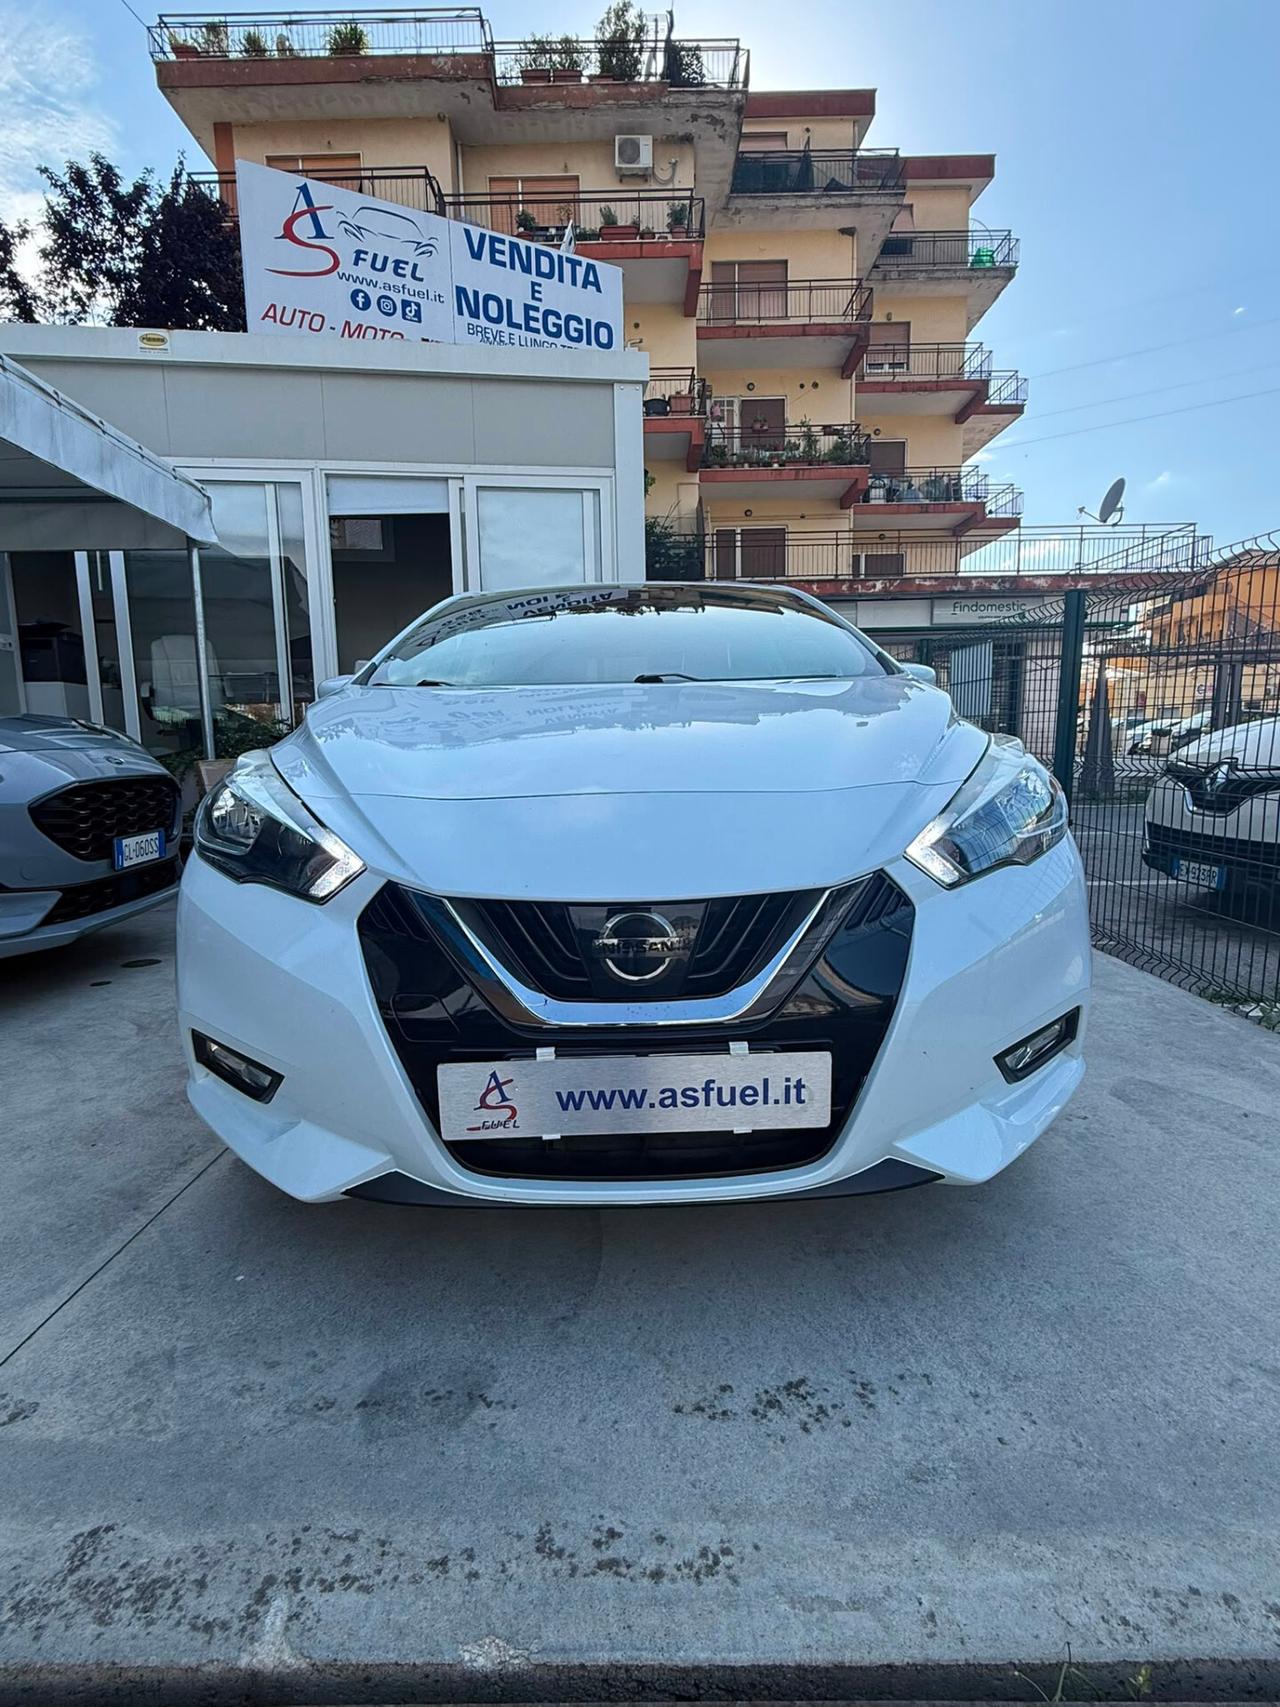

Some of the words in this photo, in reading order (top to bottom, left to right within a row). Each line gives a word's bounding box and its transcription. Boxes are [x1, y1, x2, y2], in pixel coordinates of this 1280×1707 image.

[353, 249, 425, 283] FUEL
[463, 227, 603, 294] VENDITA
[336, 271, 445, 304] www.asfuel.it
[531, 280, 543, 303] E
[260, 303, 326, 333] AUTO
[455, 285, 614, 350] NOLEGGIO
[603, 940, 674, 953] NISSAN
[555, 1077, 806, 1112] www.asfuel.it
